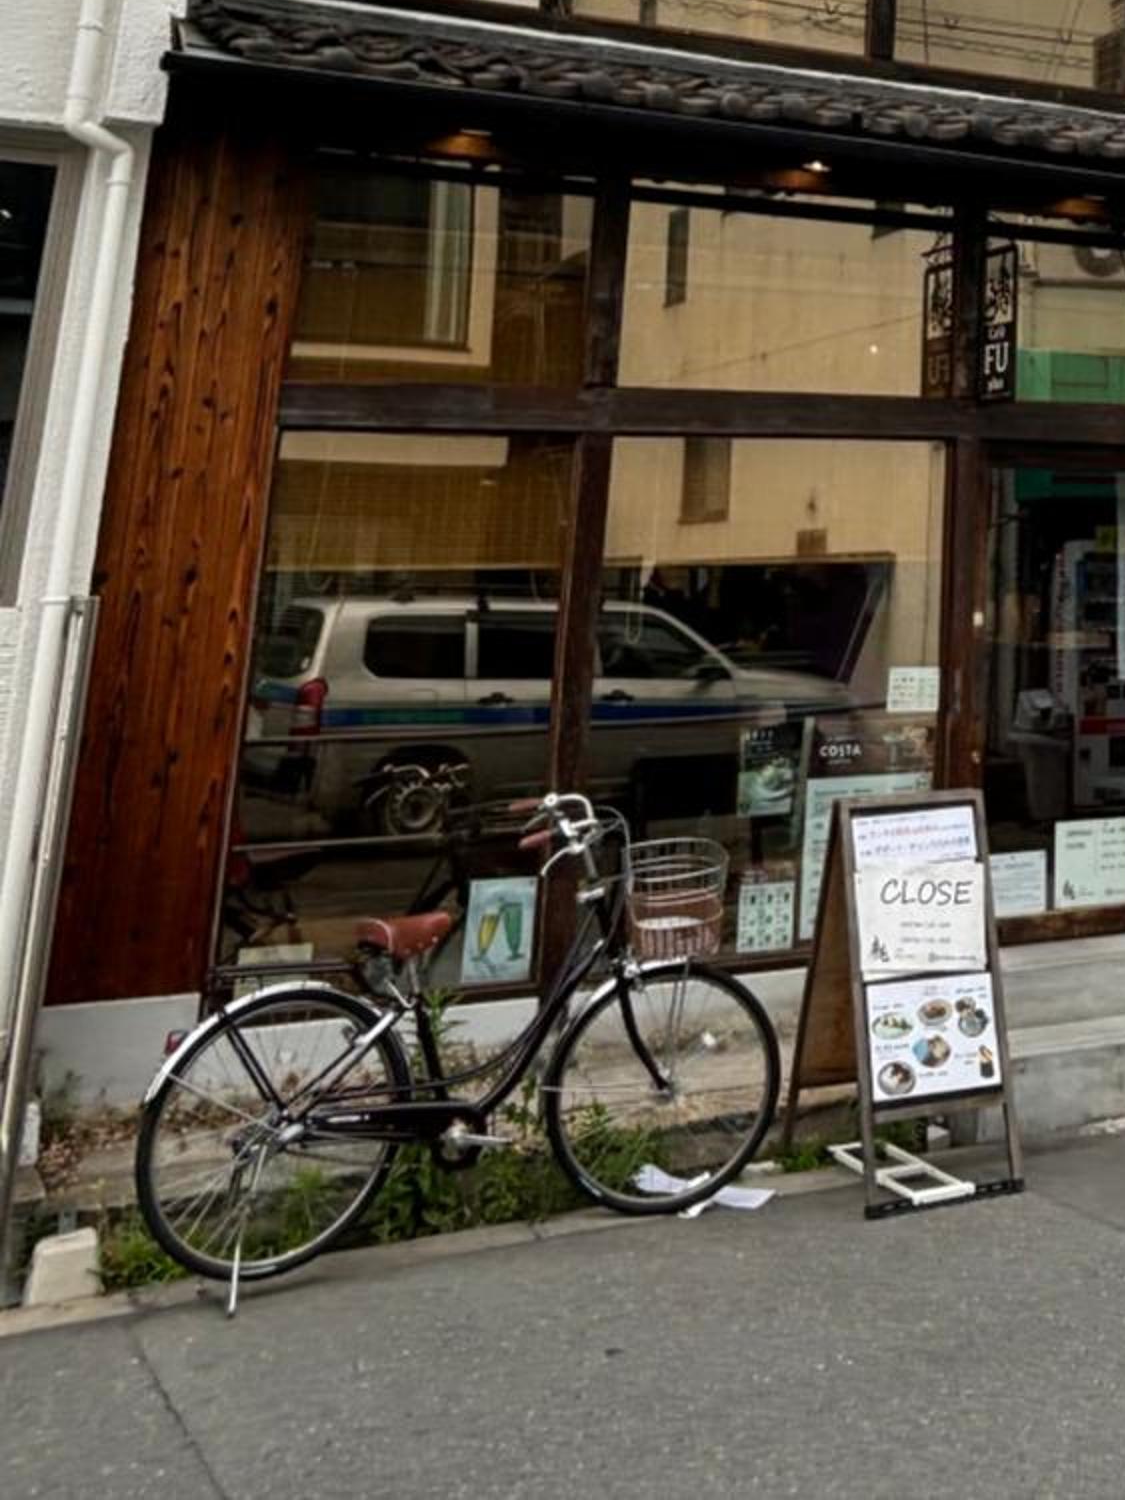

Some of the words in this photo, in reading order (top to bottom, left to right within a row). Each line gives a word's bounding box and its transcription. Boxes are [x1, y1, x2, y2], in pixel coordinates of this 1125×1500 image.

[984, 342, 1009, 374] FU
[819, 744, 861, 757] COSTA
[880, 878, 974, 905] CLOSE
